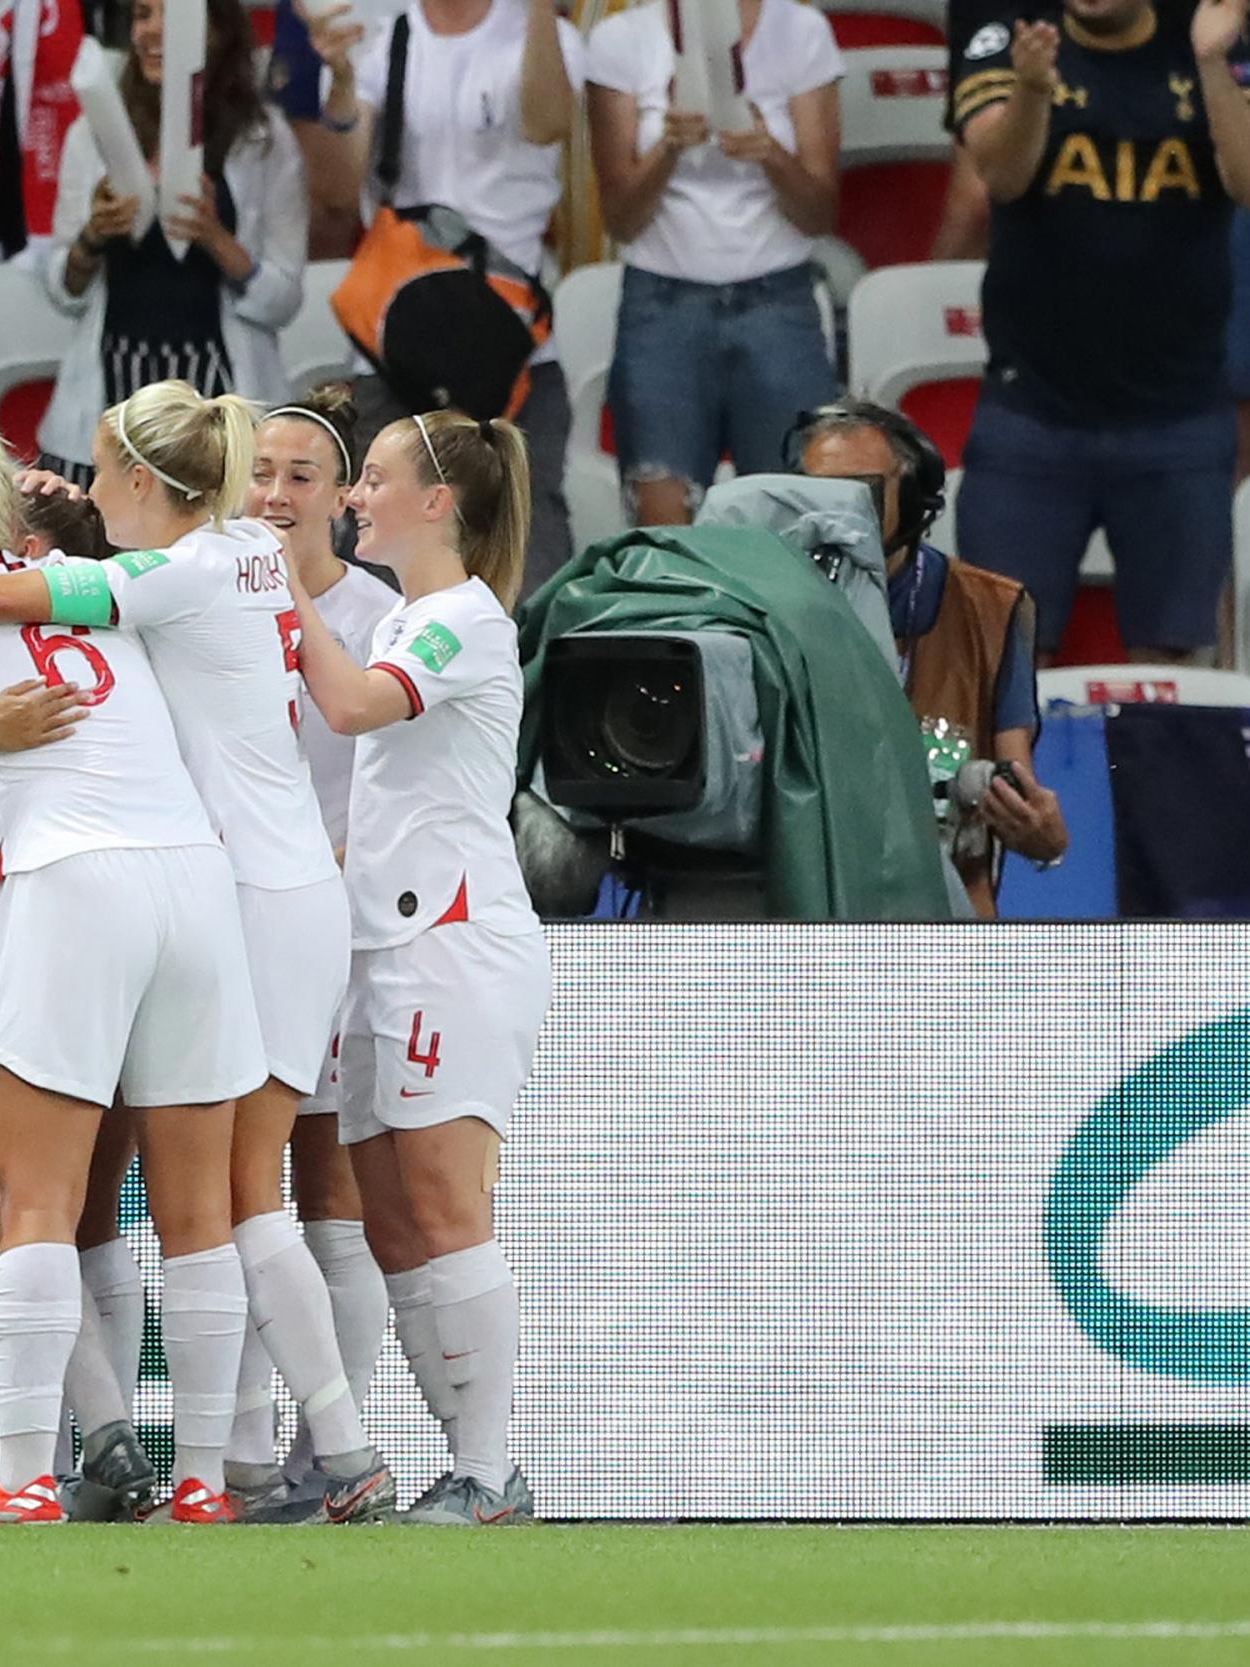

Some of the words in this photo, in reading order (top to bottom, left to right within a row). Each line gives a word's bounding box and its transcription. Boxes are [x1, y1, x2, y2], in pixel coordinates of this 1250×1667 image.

[1047, 133, 1200, 201] AIA
[19, 623, 116, 707] 6
[407, 1010, 441, 1078] 4
